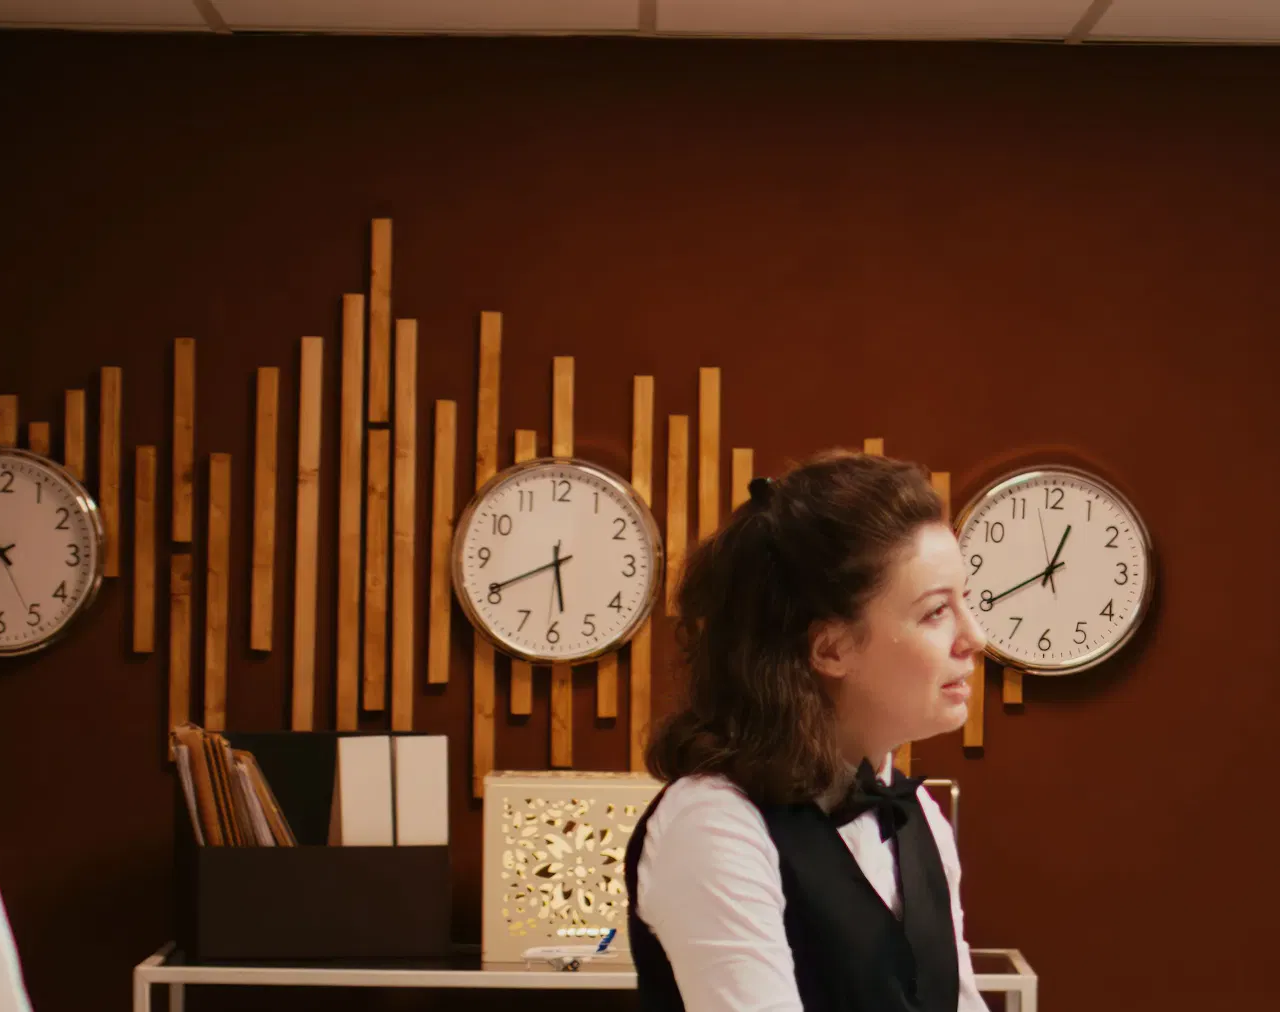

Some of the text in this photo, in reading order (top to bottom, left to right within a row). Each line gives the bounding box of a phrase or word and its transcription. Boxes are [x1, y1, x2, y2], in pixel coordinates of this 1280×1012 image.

[35, 482, 42, 504] 1
[518, 490, 534, 512] 11
[551, 480, 571, 502] 12
[1044, 487, 1065, 510] 12
[593, 492, 599, 515] 1
[1011, 497, 1026, 520] 11
[1086, 500, 1092, 522] 1
[55, 507, 70, 530] 2
[491, 513, 513, 536] 10
[612, 518, 627, 540] 2
[984, 521, 1005, 543] 10
[1104, 526, 1119, 548] 2
[65, 544, 81, 567] 3
[478, 546, 491, 569] 9
[621, 554, 637, 578] 3
[970, 554, 983, 576] 9
[1114, 562, 1129, 586] 3
[51, 580, 68, 603] 4
[487, 582, 502, 605] 8
[607, 590, 623, 614] 4
[979, 589, 994, 612] 8
[26, 603, 41, 627] 5
[517, 609, 532, 632] 7
[1099, 598, 1115, 622] 4
[545, 621, 560, 644] 6
[581, 613, 596, 637] 5
[1009, 617, 1023, 640] 7
[1073, 621, 1088, 645] 5
[1037, 628, 1052, 651] 6
